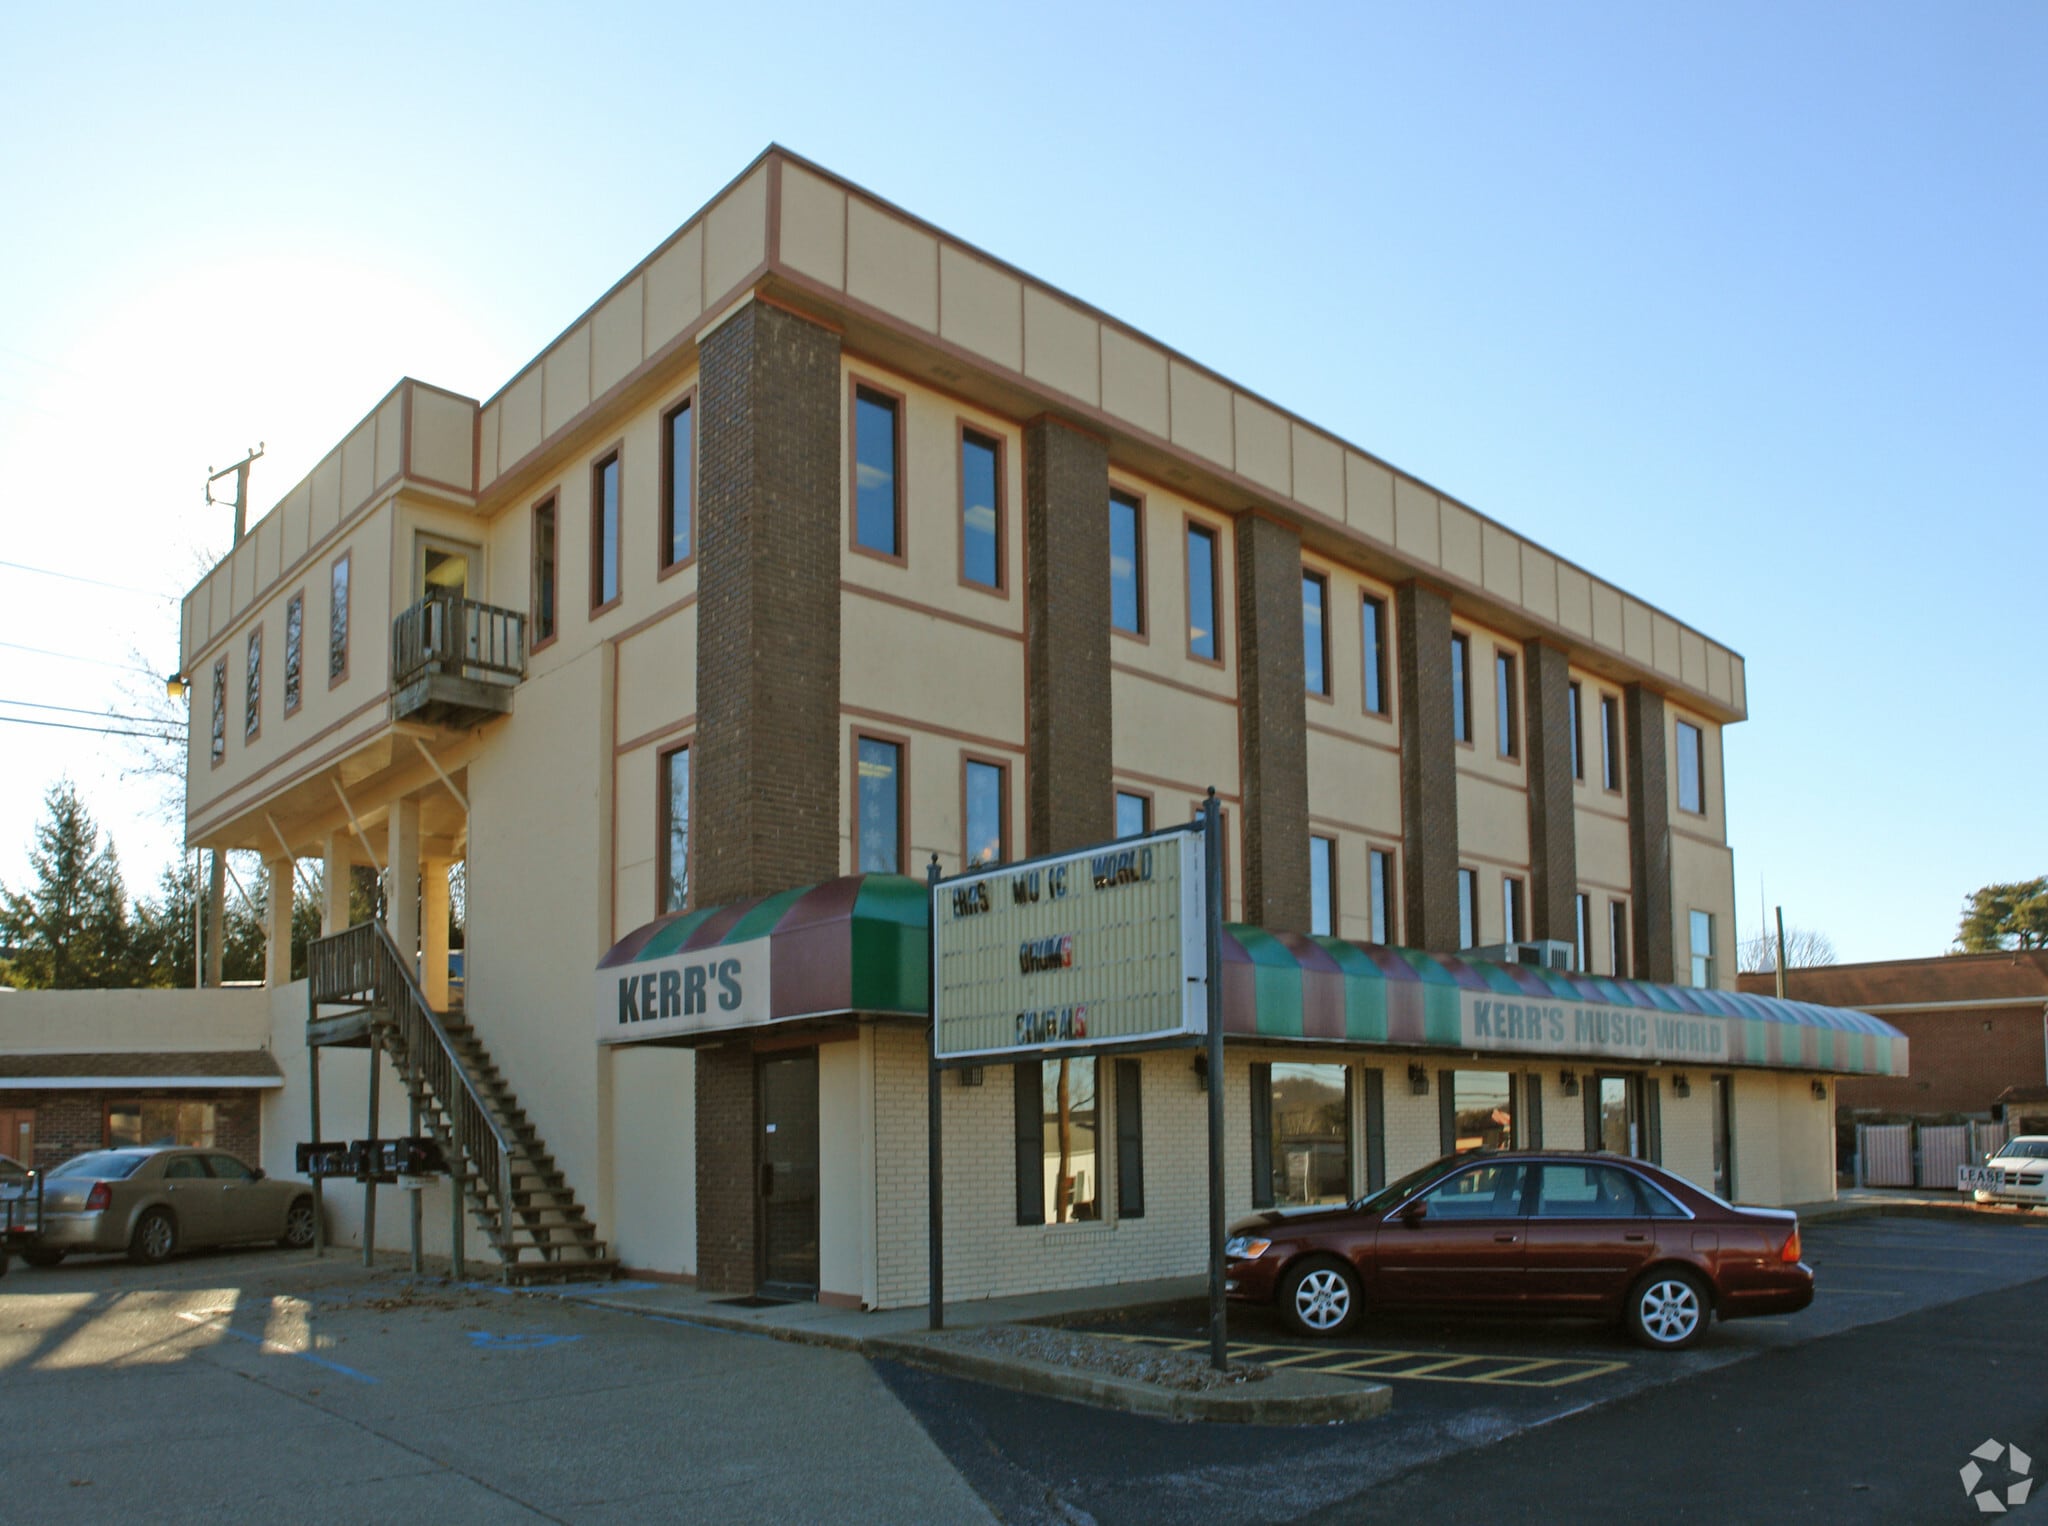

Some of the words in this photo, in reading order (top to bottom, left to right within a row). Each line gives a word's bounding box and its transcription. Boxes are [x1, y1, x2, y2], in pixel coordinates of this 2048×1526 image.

[1093, 847, 1153, 890] WORLD
[1019, 934, 1072, 975] DRUMS
[618, 958, 742, 1025] KERR'S
[1473, 1000, 1565, 1043] KERR'S
[1574, 1008, 1647, 1047] MUSIC
[1655, 1017, 1722, 1054] WORLD
[1960, 1168, 2004, 1184] LEASE
